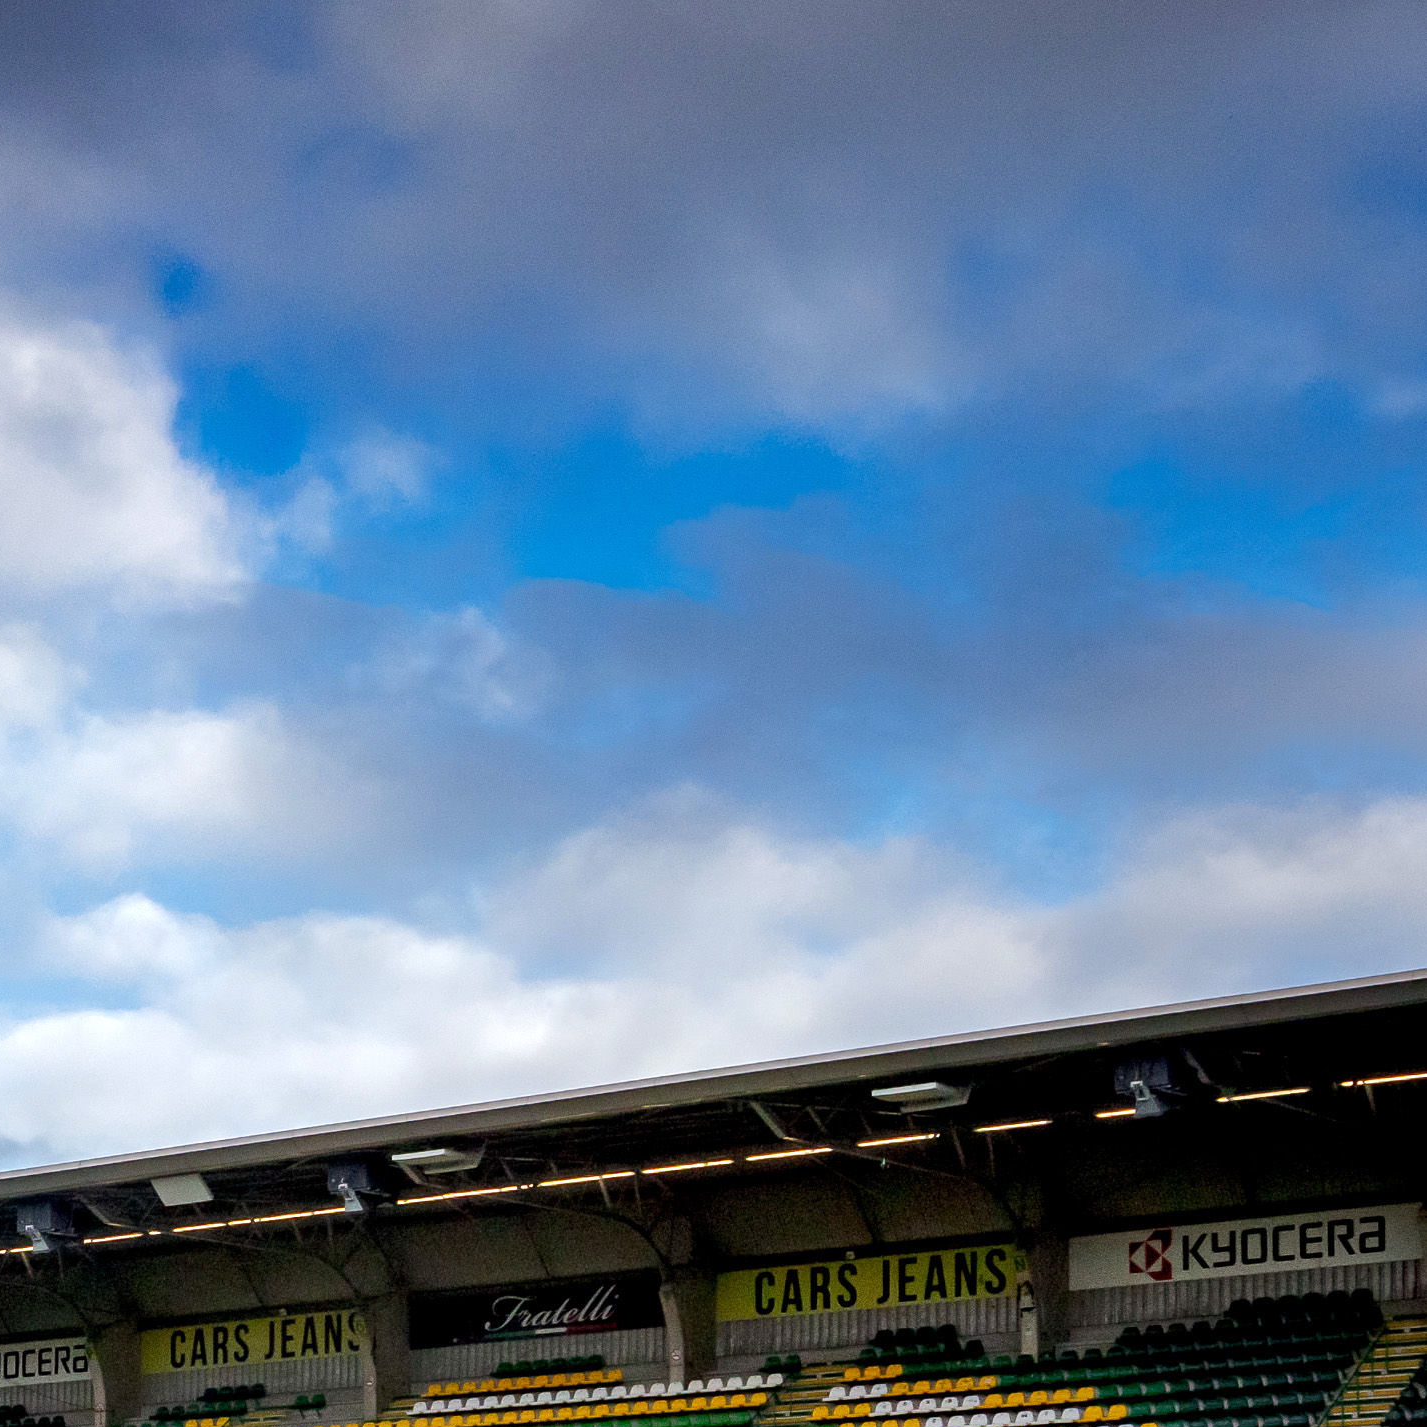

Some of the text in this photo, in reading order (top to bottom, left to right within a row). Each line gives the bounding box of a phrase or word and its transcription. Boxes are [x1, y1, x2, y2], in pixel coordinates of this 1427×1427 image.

[484, 1284, 620, 1331] Fratelli
[755, 1248, 1007, 1315] CARS JEANS
[170, 1312, 360, 1368] CARS JEANS
